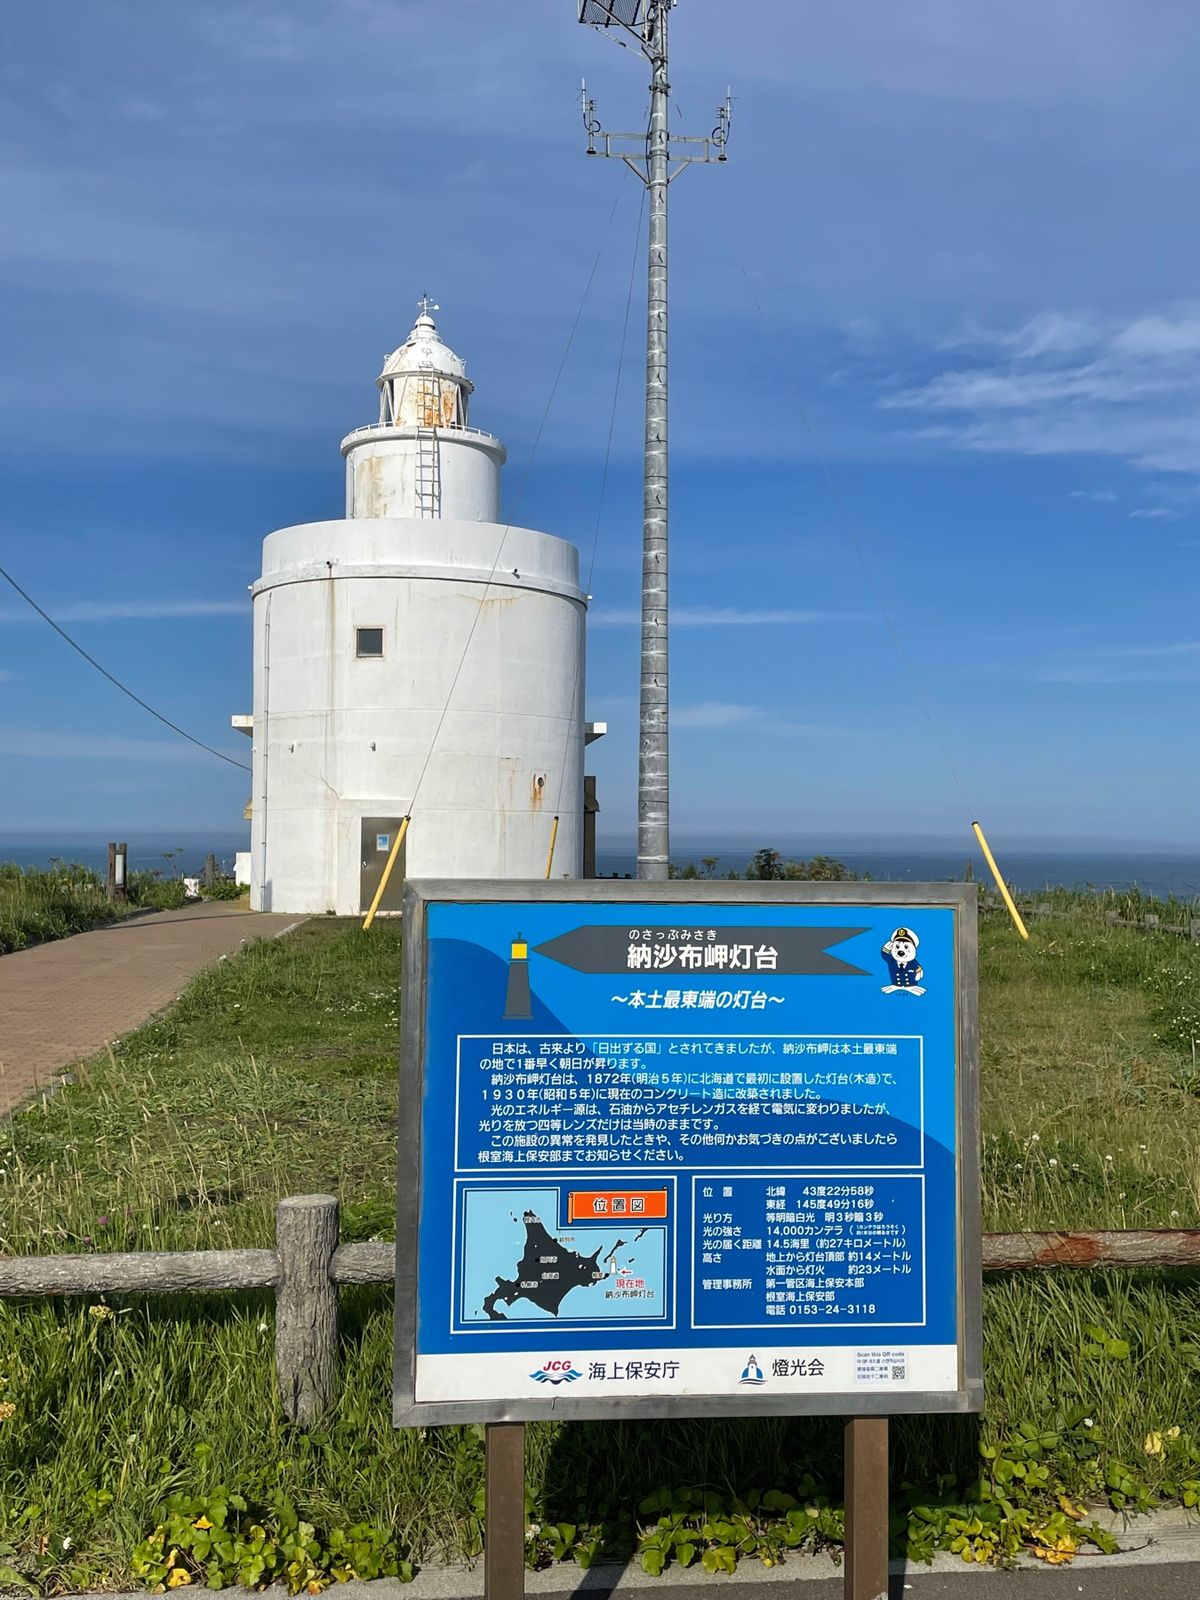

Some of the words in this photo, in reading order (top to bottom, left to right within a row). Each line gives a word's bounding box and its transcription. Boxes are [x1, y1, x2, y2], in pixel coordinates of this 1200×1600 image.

[628, 928, 718, 941] のさっぷみさき
[627, 944, 778, 970] 納沙布岬灯台
[478, 1149, 685, 1163] 根室海上保安部までお知らせください。
[766, 1186, 786, 1197] 北緯
[766, 1199, 786, 1210] 東経
[702, 1213, 733, 1223] 光り方
[702, 1226, 742, 1237] 光の強さ
[702, 1239, 762, 1250] 光の届く距離
[702, 1252, 722, 1264] 高さ
[765, 1251, 845, 1262] 地上から灯台頂部
[848, 1251, 912, 1262] 約14メートル
[765, 1265, 825, 1276] 水面から灯火
[848, 1264, 912, 1275] 約23メートル
[615, 1279, 645, 1289] 現在地
[702, 1278, 752, 1290] 管理事務所
[765, 1277, 865, 1289] 第一管区海上保安本部
[765, 1291, 835, 1302] 根室海上保安部
[765, 1304, 786, 1316] 電話
[789, 1304, 876, 1315] 0153-24-3118
[542, 1360, 573, 1371] JCG
[588, 1361, 681, 1380] 海上保安庁
[771, 1358, 825, 1378] 燈光会
